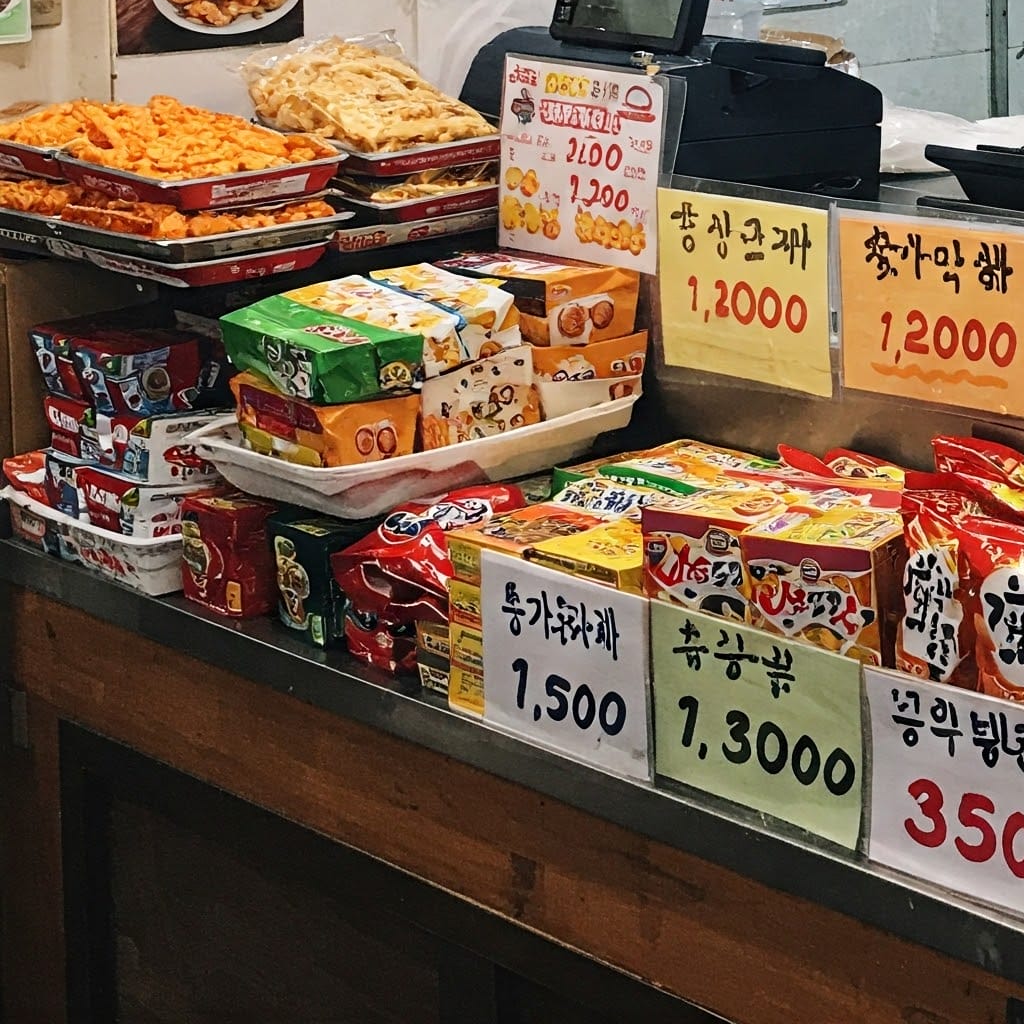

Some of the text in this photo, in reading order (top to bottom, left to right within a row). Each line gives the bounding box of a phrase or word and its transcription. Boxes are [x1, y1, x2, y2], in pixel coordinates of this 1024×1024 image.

[688, 275, 807, 334] 1,2000
[881, 310, 1017, 367] 1,2000
[512, 658, 627, 736] 1,500
